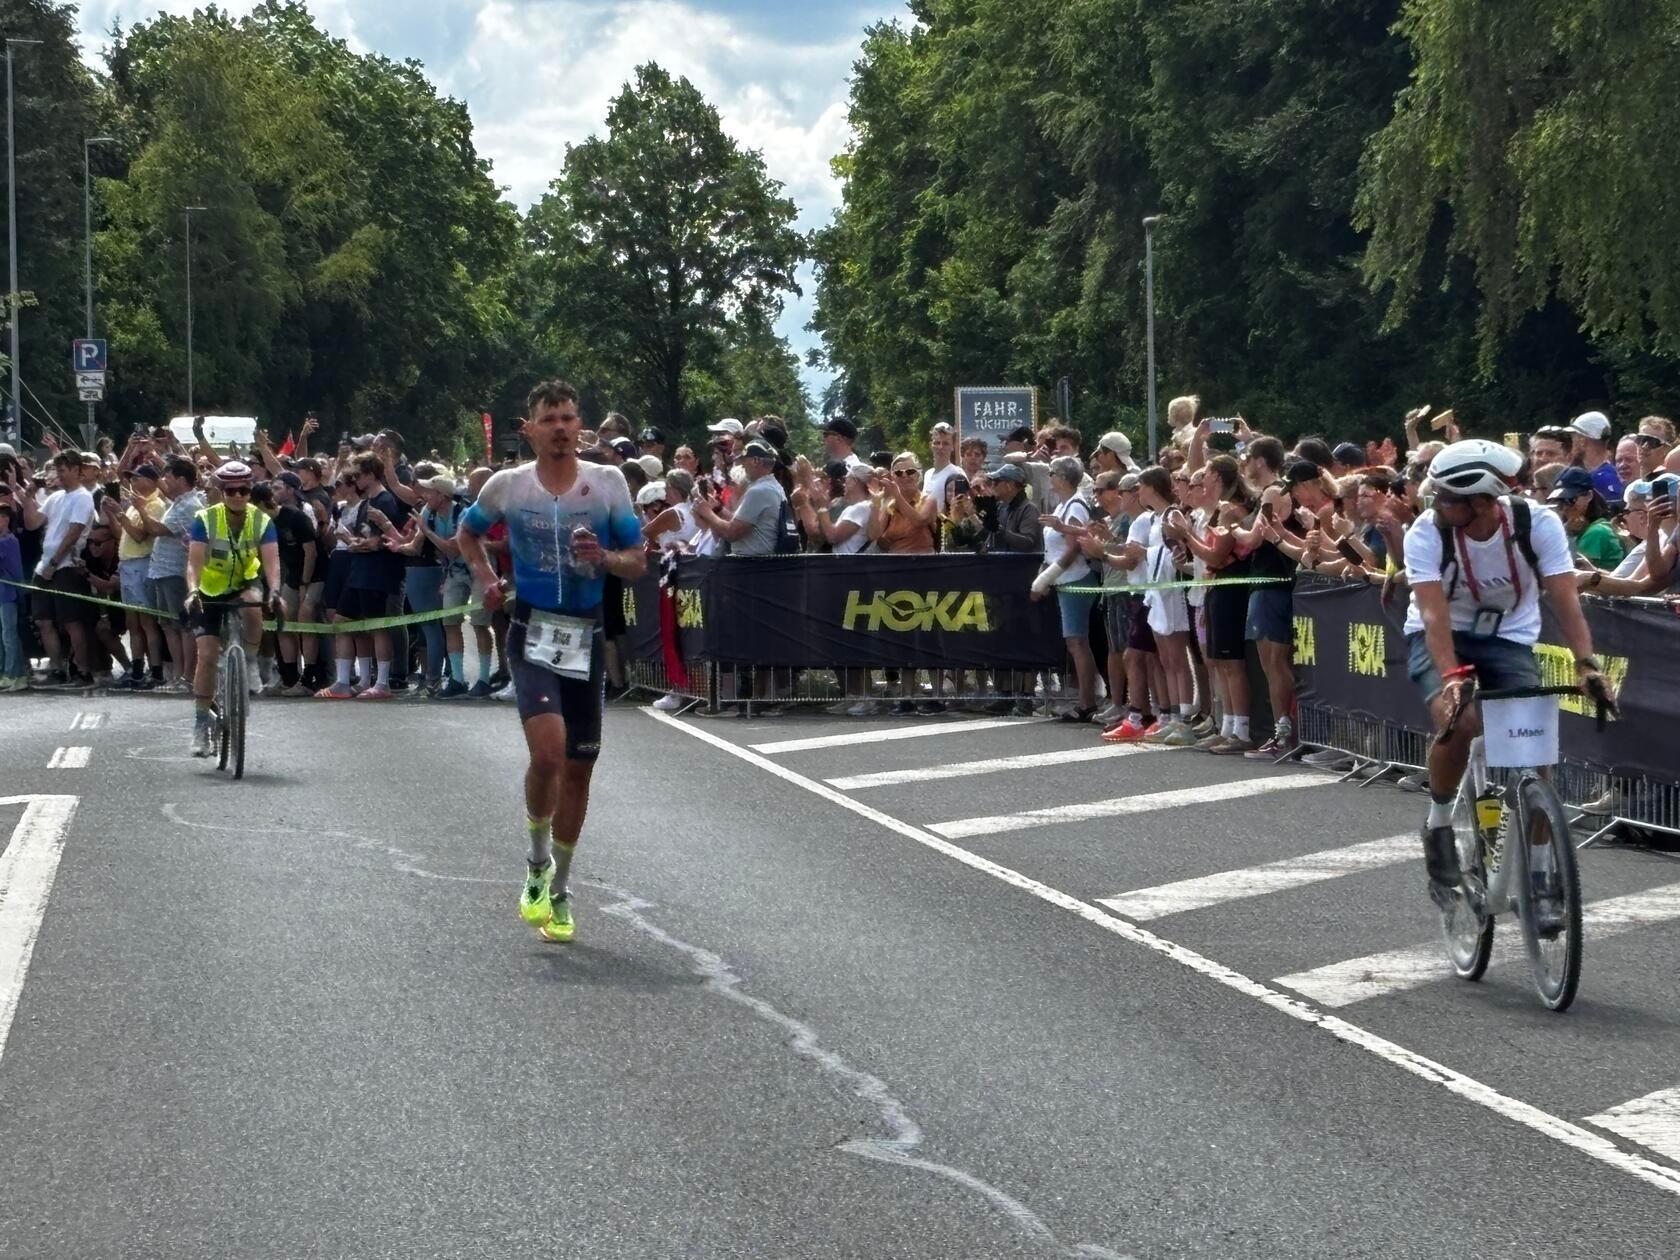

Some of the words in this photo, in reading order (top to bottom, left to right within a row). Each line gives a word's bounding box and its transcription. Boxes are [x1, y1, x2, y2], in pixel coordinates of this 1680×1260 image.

[82, 343, 99, 368] P
[974, 401, 1023, 417] FAHR-
[842, 590, 990, 632] HOKA
[1348, 621, 1387, 678] HOKA
